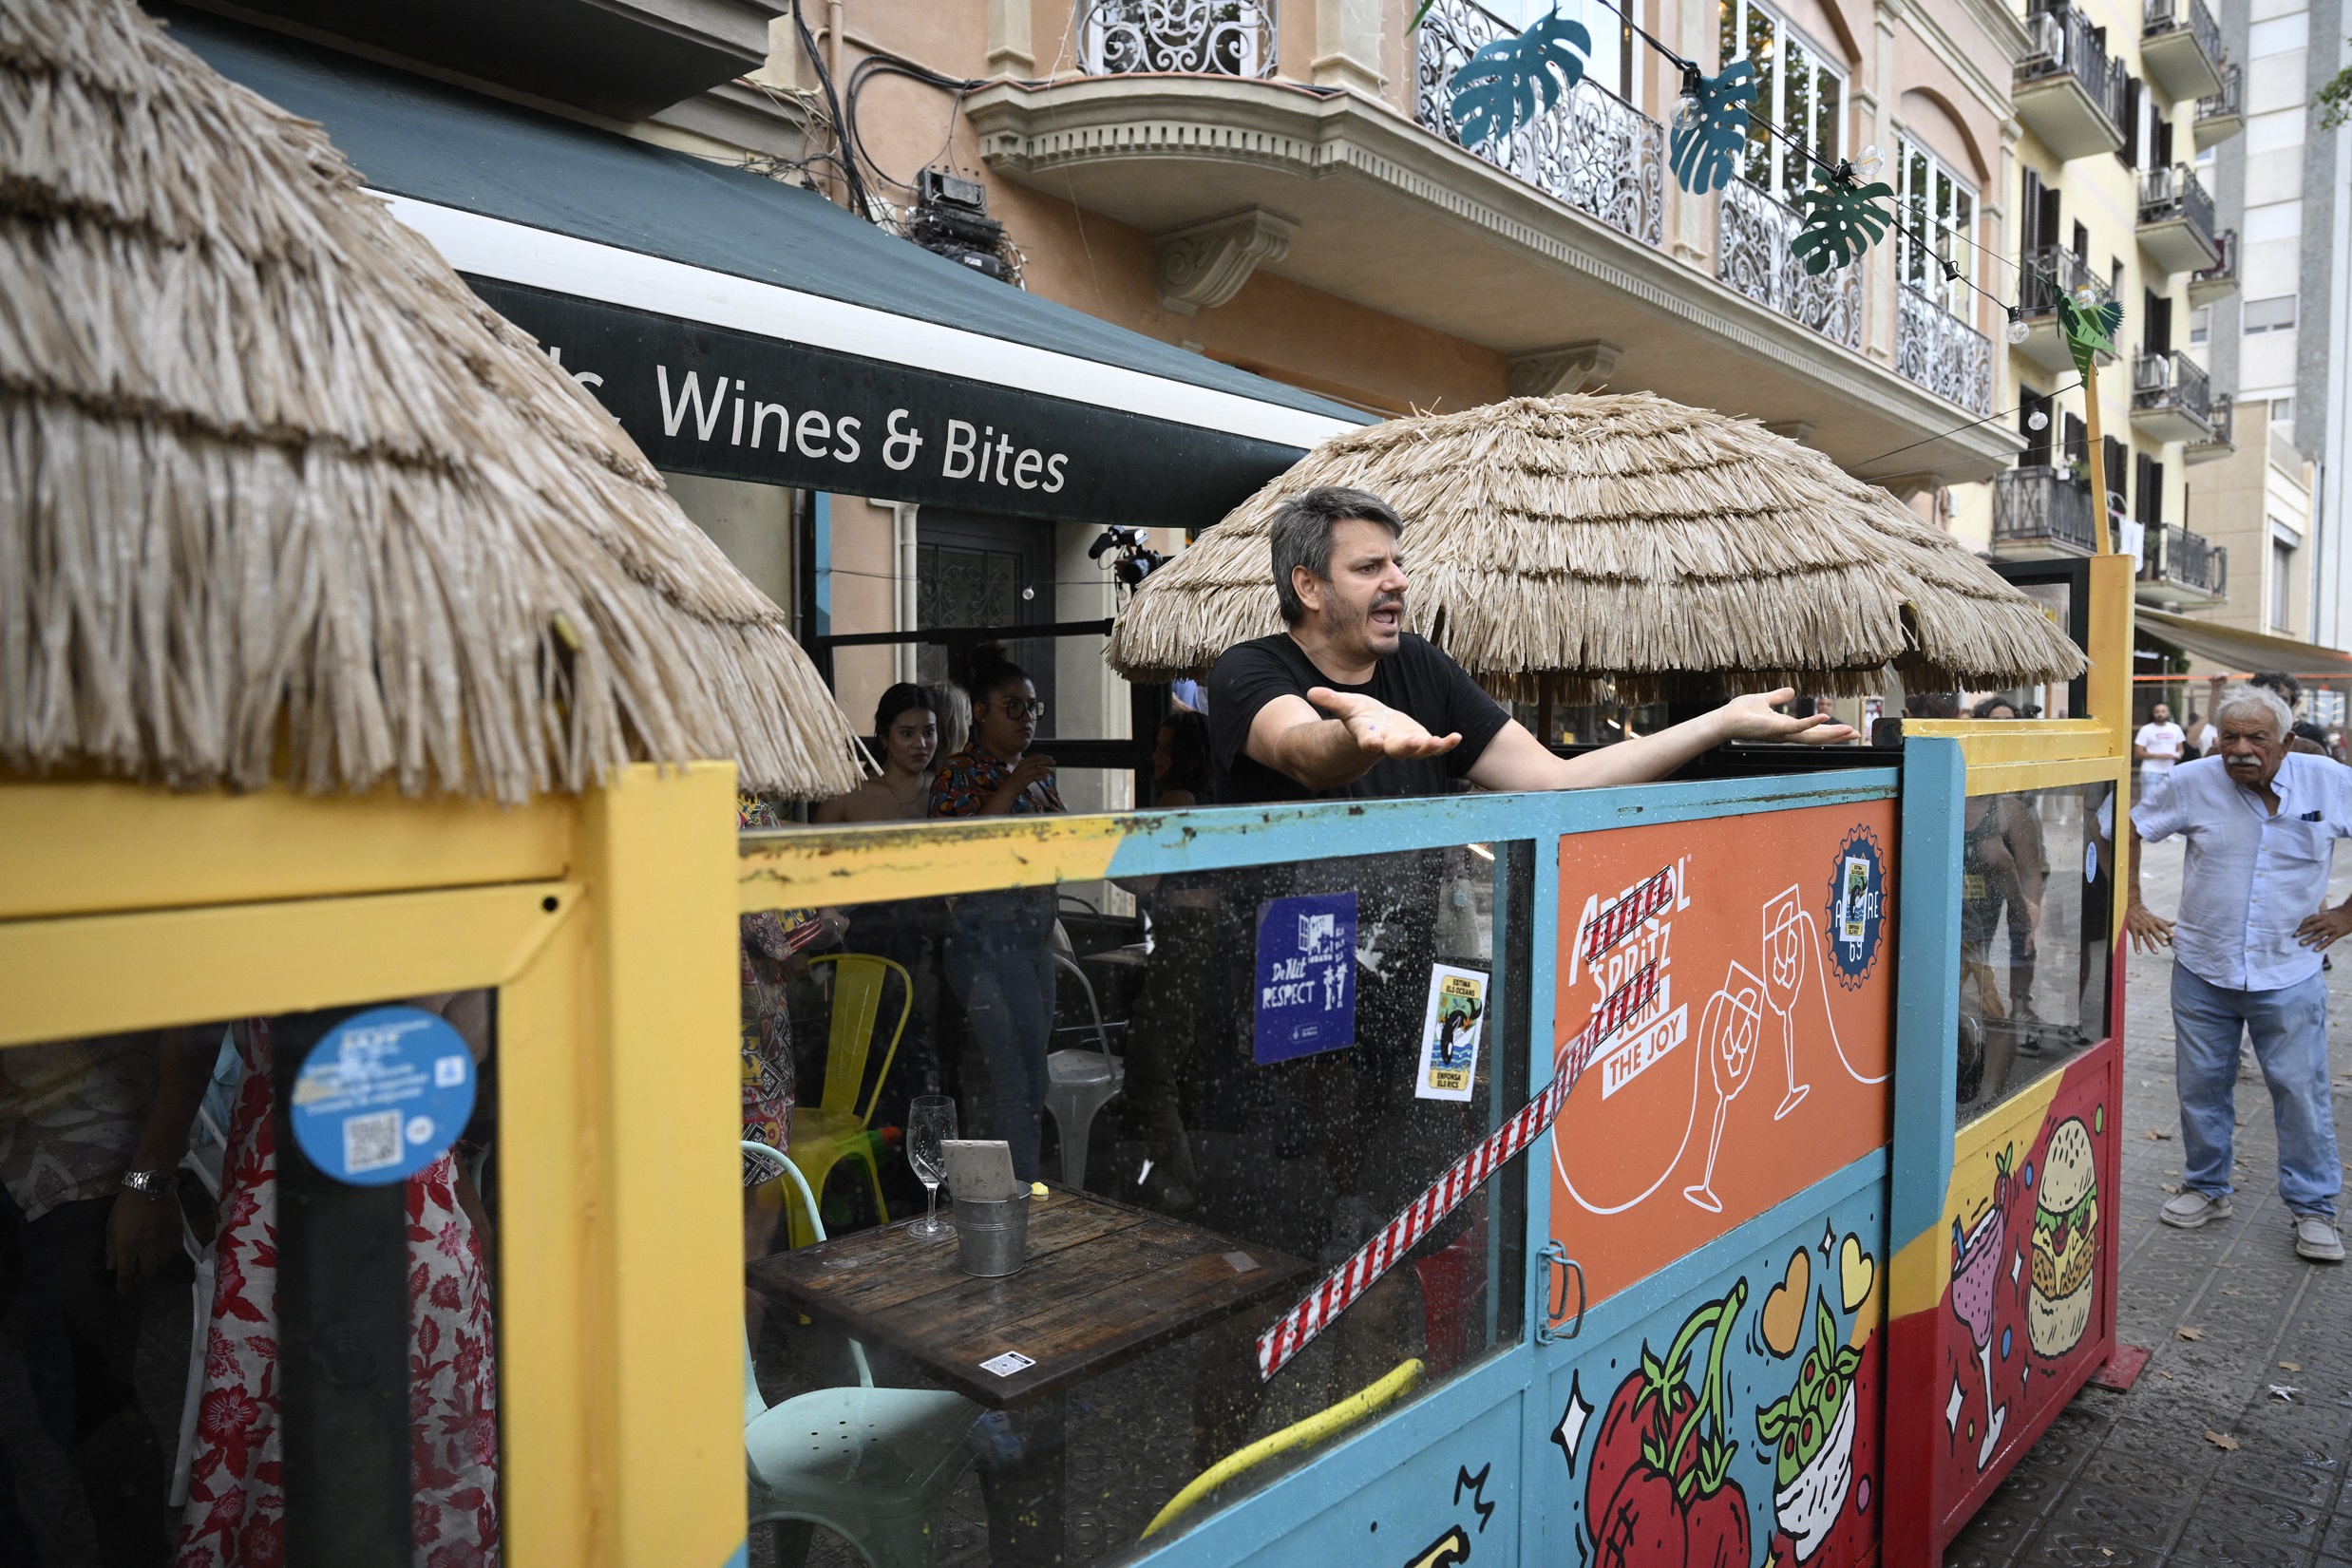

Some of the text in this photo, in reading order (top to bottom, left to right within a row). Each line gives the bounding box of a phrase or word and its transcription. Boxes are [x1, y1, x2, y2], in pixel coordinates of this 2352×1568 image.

[656, 364, 862, 464] Wines
[882, 408, 923, 471] &
[942, 419, 1070, 494] Bites
[1849, 941, 1863, 963] 69
[1446, 985, 1475, 997] ELS OCEANS
[1452, 978, 1471, 988] ESTIMA
[1262, 980, 1316, 1009] RESPECT
[1609, 1013, 1681, 1087] THE JOY
[1436, 1072, 1461, 1081] ENFONSA
[1447, 1080, 1459, 1088] RICS
